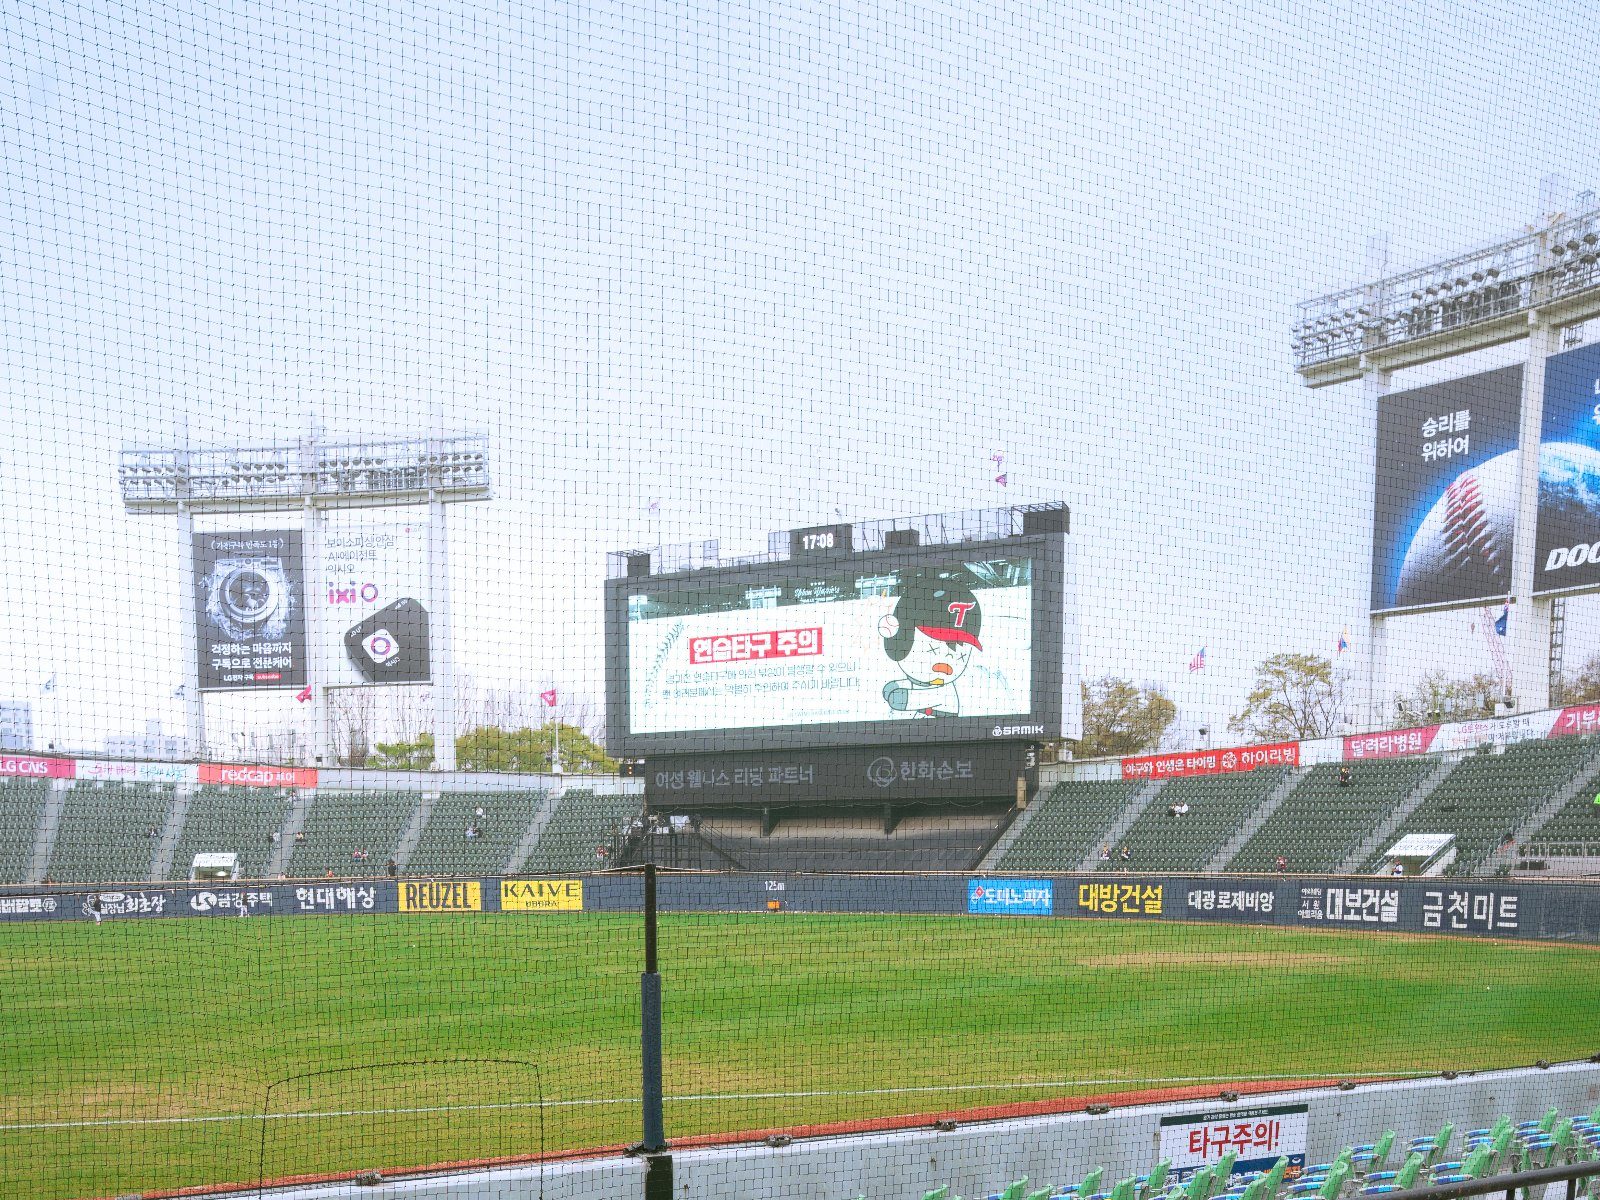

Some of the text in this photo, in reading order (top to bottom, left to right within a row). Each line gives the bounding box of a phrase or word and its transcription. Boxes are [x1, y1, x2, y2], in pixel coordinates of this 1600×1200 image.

[1421, 409, 1471, 438] 승리를
[1421, 435, 1470, 462] 위하여
[803, 533, 834, 550] 17:08
[948, 601, 977, 627] T
[211, 642, 292, 656] 걱정하는 마음까지
[693, 629, 818, 663] 연습타구 주의
[212, 658, 252, 670] 구독으로
[1241, 747, 1296, 764] 하이리빙
[1351, 732, 1422, 758] 달려라병원
[19, 761, 48, 774] CNS
[221, 767, 273, 785] redcap
[656, 771, 684, 790] 여성
[687, 769, 730, 789] 웰니스
[768, 764, 814, 784] 파트너
[901, 761, 973, 783] 한화손보
[1156, 760, 1184, 773] 인생은
[295, 887, 376, 910] 현대해상
[405, 882, 471, 910] REUZEL
[504, 883, 580, 898] KAIVE
[984, 888, 1051, 908] 도미노피자
[1078, 883, 1163, 914] 대방건설
[1188, 891, 1275, 913] 대광 로제비앙
[1326, 888, 1398, 922] 대보건설
[1423, 890, 1518, 930] 금천미트
[1189, 1120, 1280, 1158] 타구주의!
